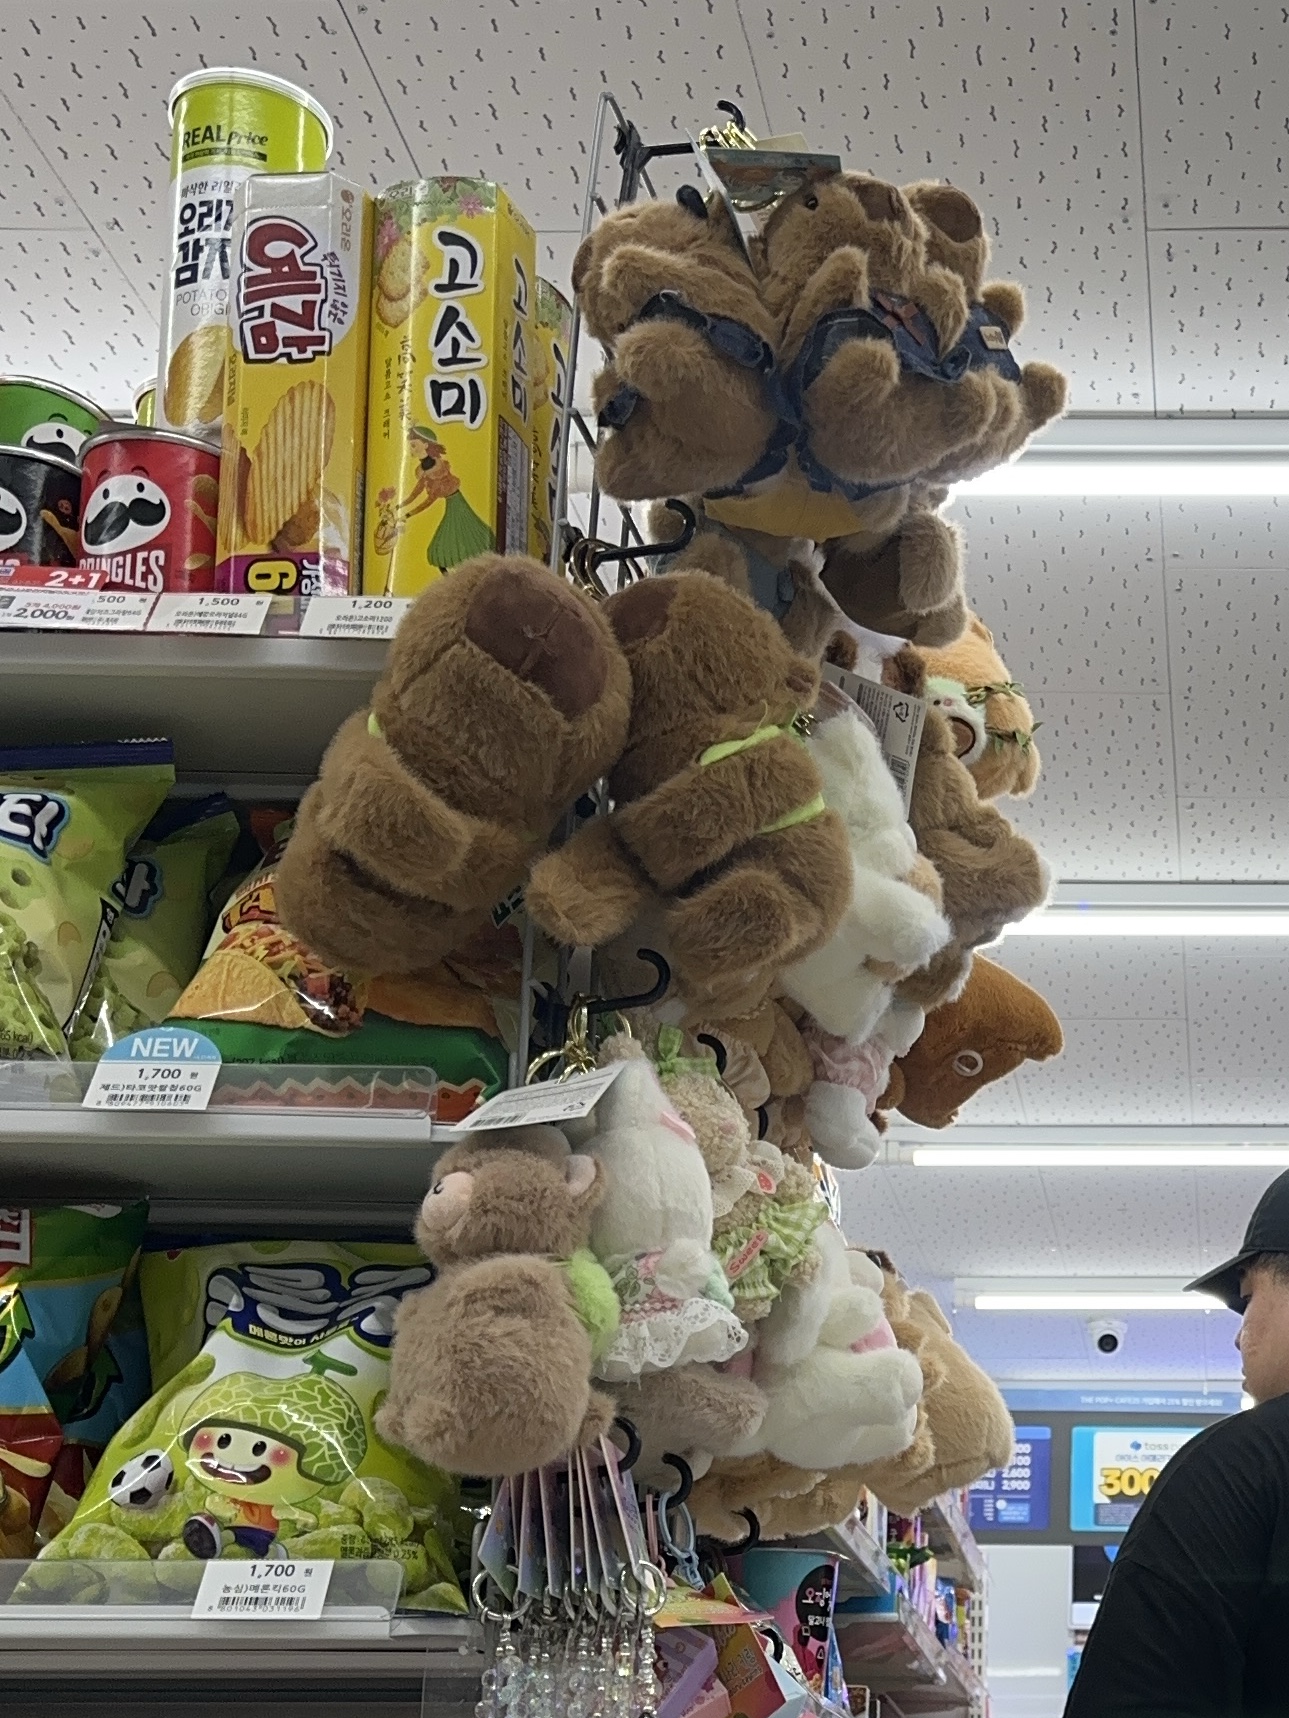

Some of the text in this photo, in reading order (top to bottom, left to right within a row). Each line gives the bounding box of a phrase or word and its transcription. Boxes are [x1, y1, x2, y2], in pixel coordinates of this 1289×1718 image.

[183, 125, 228, 148] REAL
[176, 289, 228, 305] POTATO
[240, 216, 332, 364] 예감
[428, 231, 483, 425] 고소미
[511, 256, 529, 425] 고소미
[44, 571, 101, 589] 2+1
[199, 597, 240, 607] 1,500
[350, 600, 393, 610] 1,200
[130, 1037, 200, 1060] NEW
[137, 1068, 182, 1081] 1,700
[1144, 1440, 1169, 1451] toss
[249, 1564, 296, 1580] 1,700
